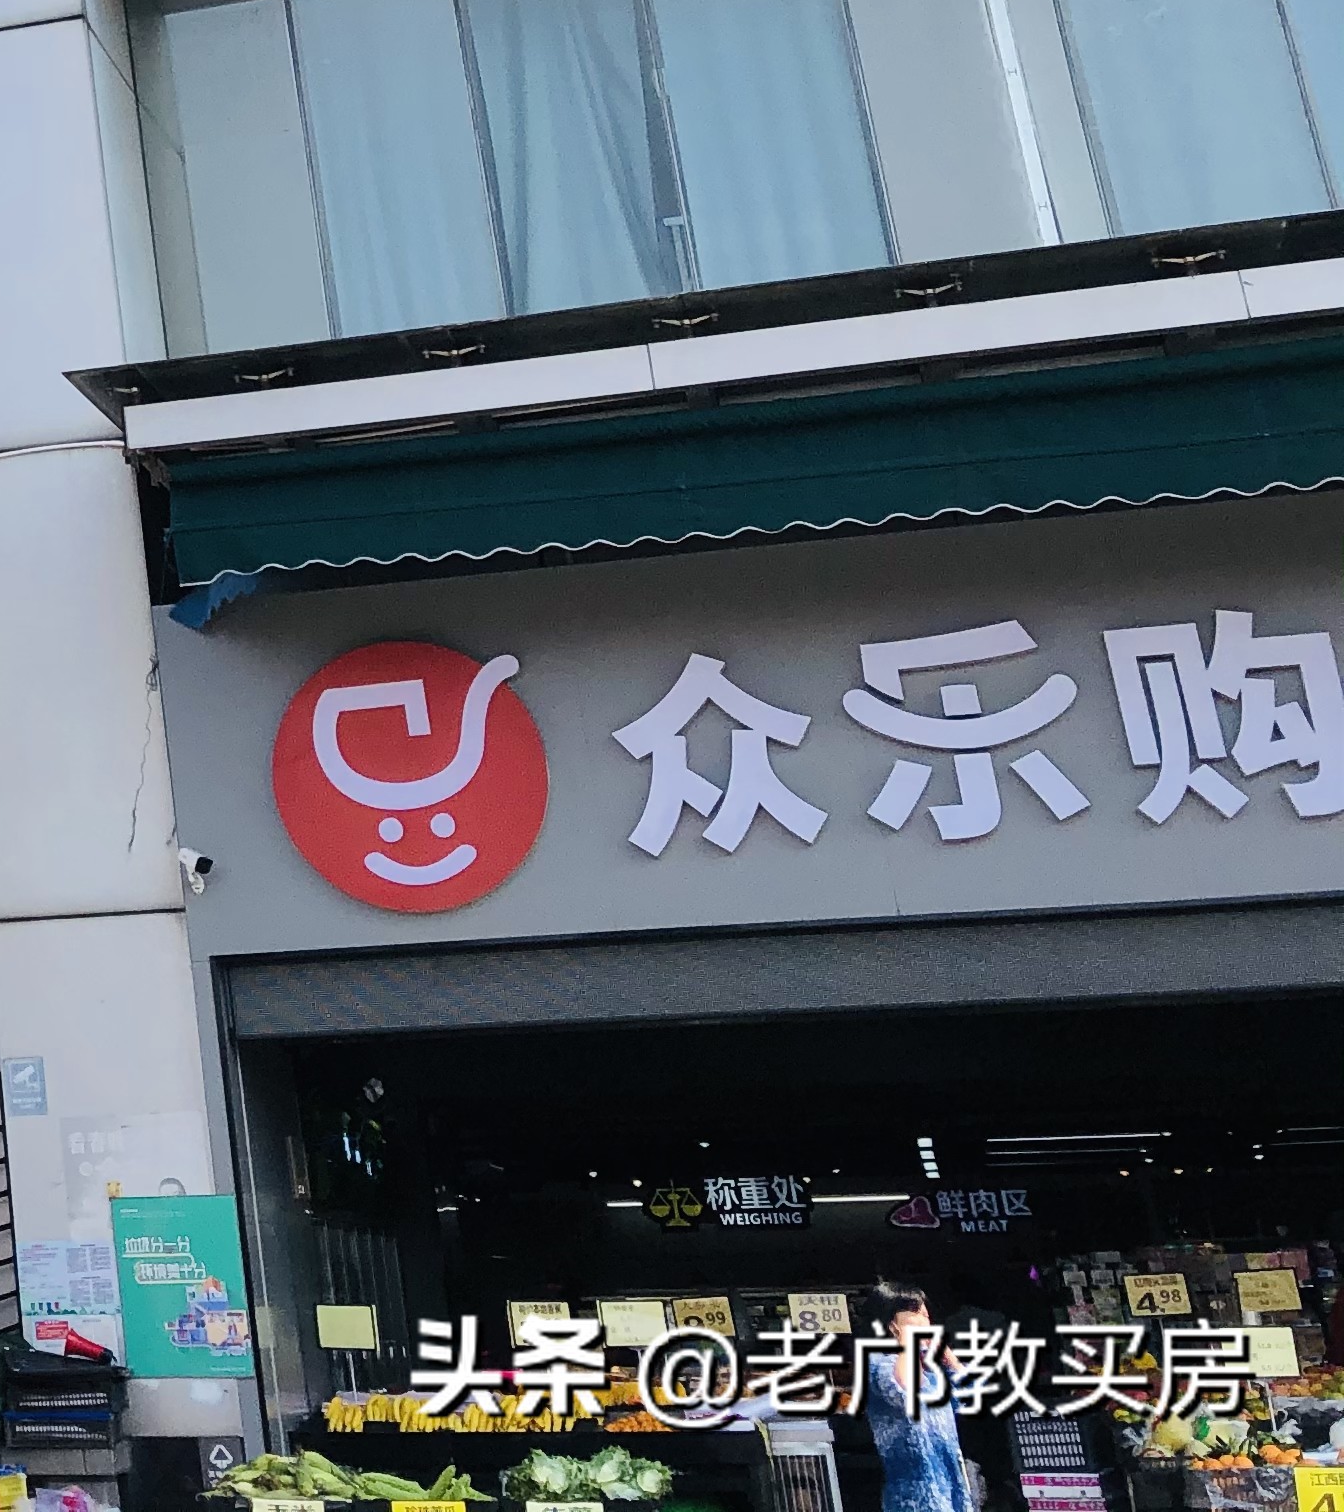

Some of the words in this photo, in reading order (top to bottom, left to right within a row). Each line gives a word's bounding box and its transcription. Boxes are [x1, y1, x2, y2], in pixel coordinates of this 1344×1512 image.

[612, 609, 1344, 856] 众乐购
[704, 1176, 807, 1211] 称重处
[936, 1189, 1032, 1218] 鲜肉区
[719, 1211, 803, 1226] WEIGHING
[961, 1220, 1009, 1233] MEAT
